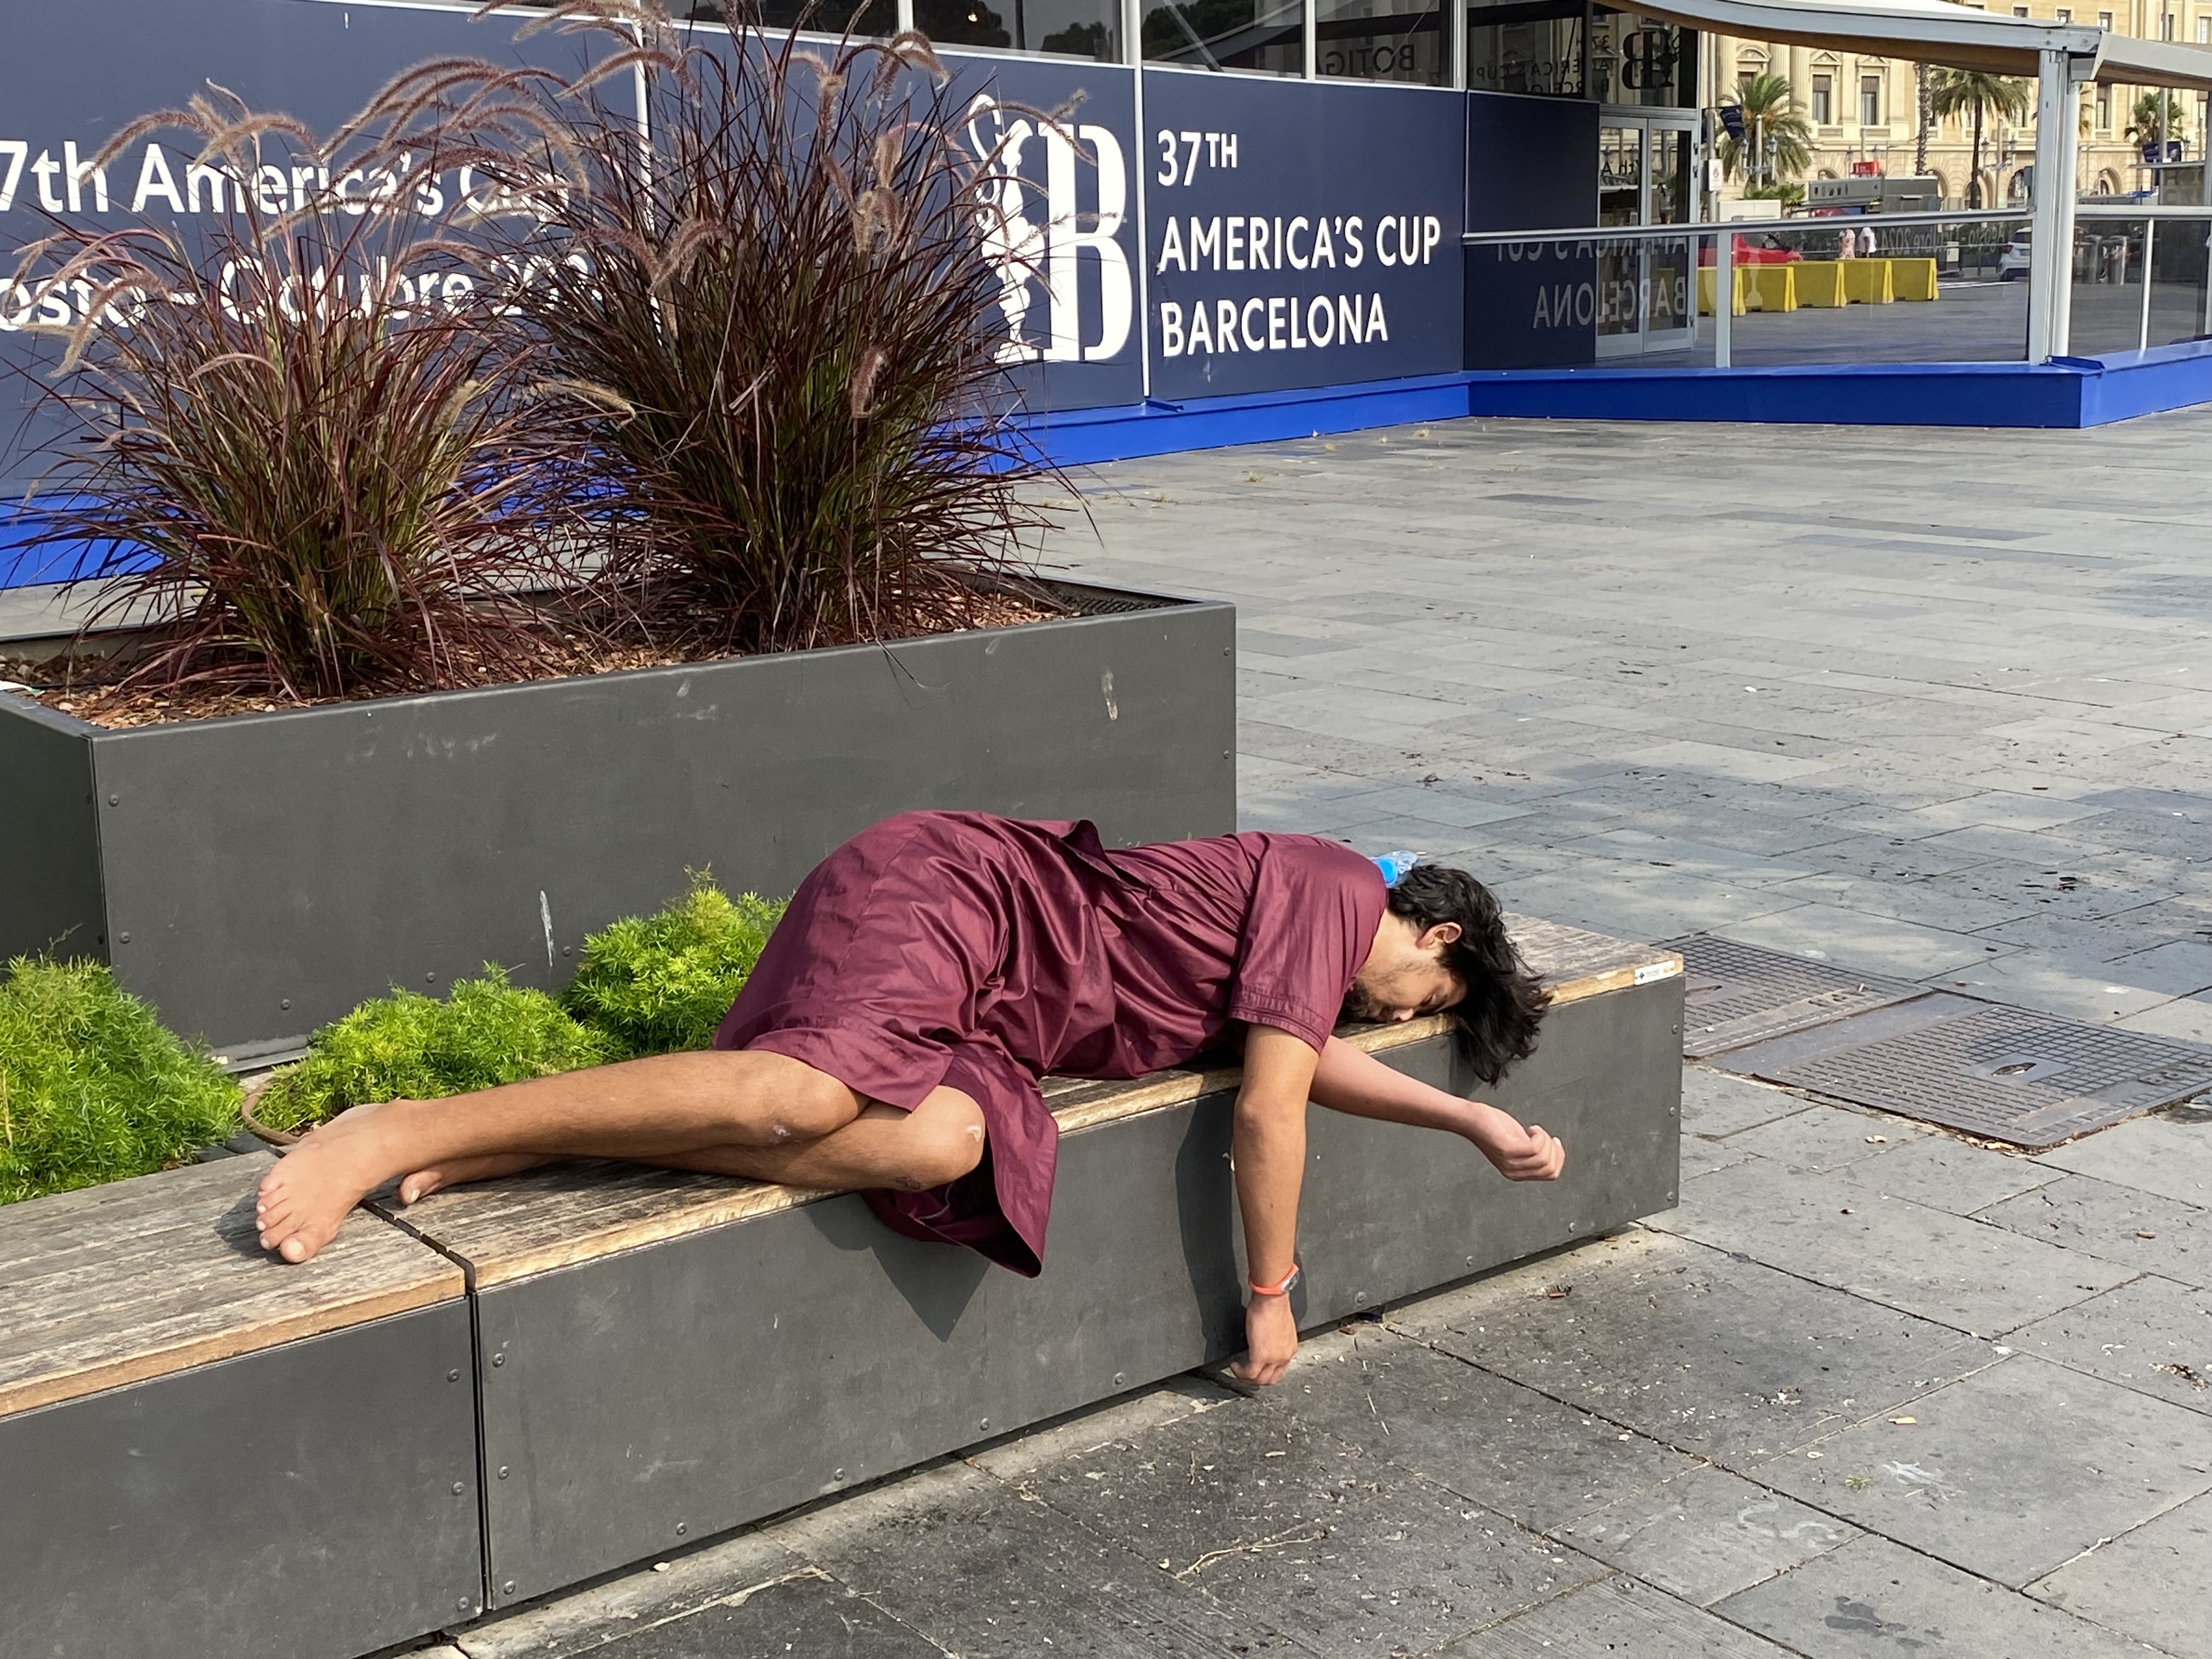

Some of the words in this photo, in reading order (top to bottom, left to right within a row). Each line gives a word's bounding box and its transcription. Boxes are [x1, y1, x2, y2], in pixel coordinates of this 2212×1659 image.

[131, 143, 444, 216] America's
[1158, 129, 1238, 187] 37TH
[1157, 216, 1364, 275] AMERICA'S
[1376, 216, 1441, 266] CUP
[1160, 293, 1388, 358] BARCELONA
